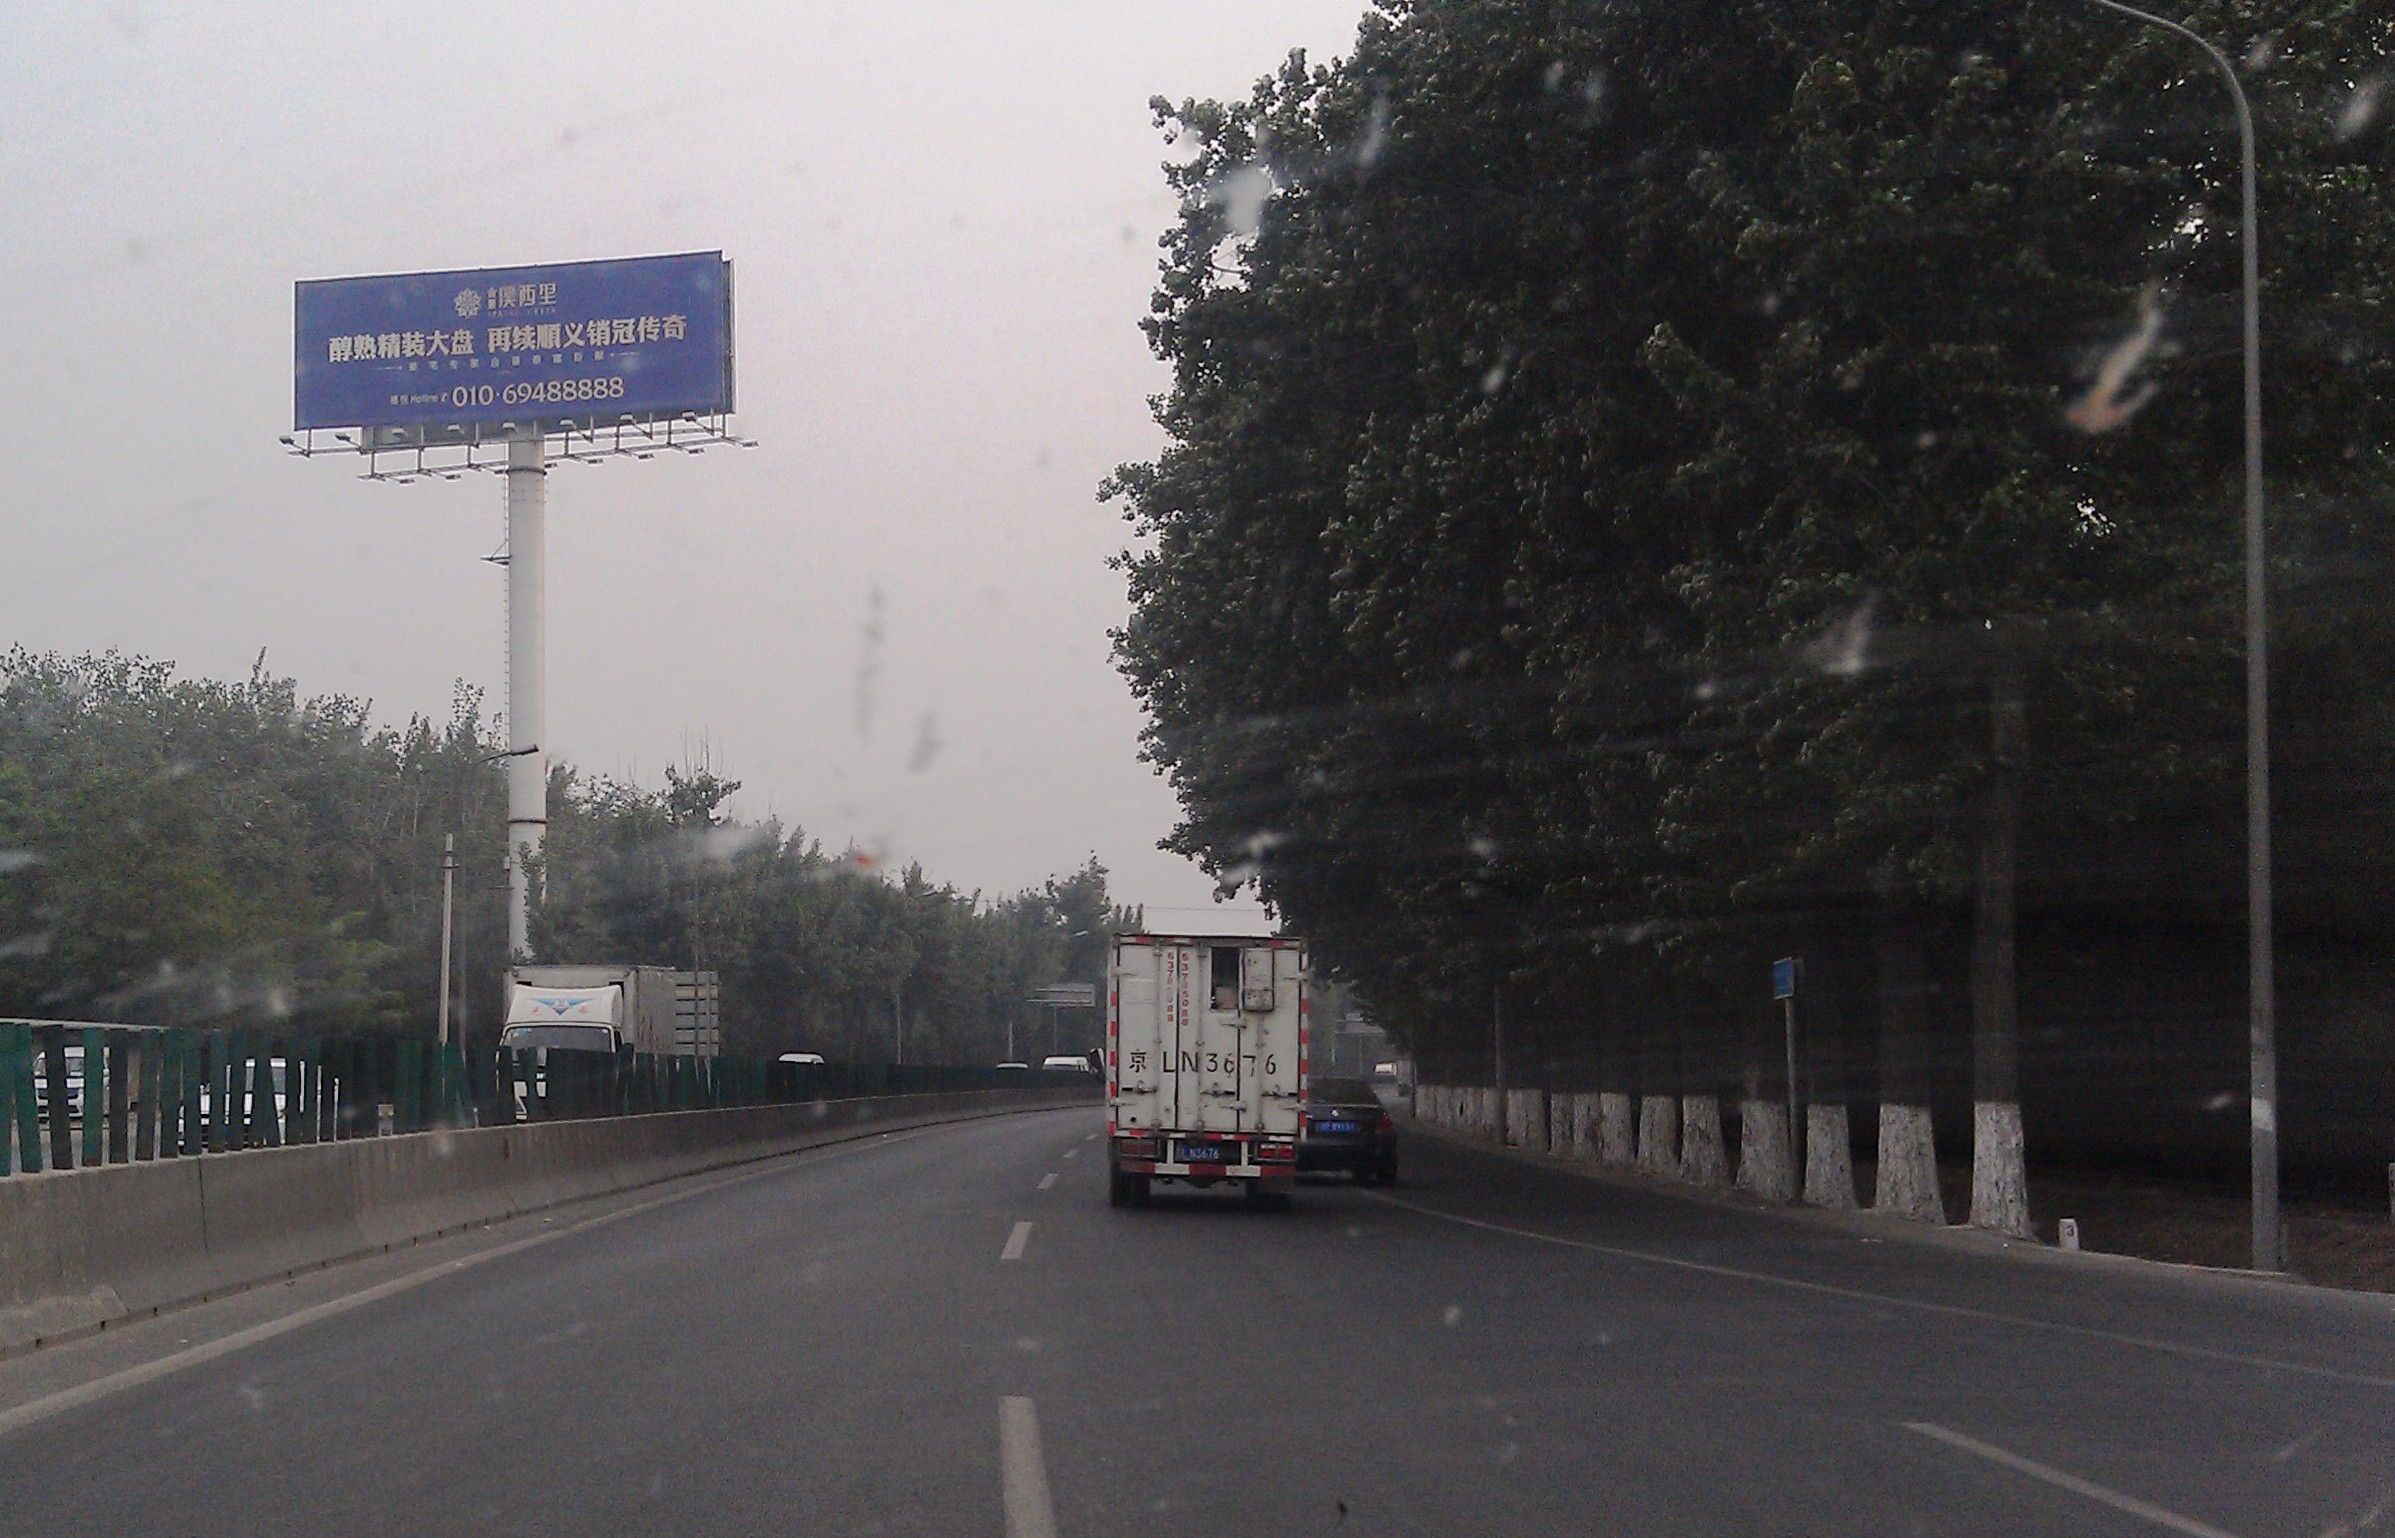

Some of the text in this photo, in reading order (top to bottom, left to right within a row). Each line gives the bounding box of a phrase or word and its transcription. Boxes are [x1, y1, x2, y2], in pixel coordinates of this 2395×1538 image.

[328, 330, 474, 363] 醇熟精装大盘
[1176, 1147, 1220, 1160] LN3676
